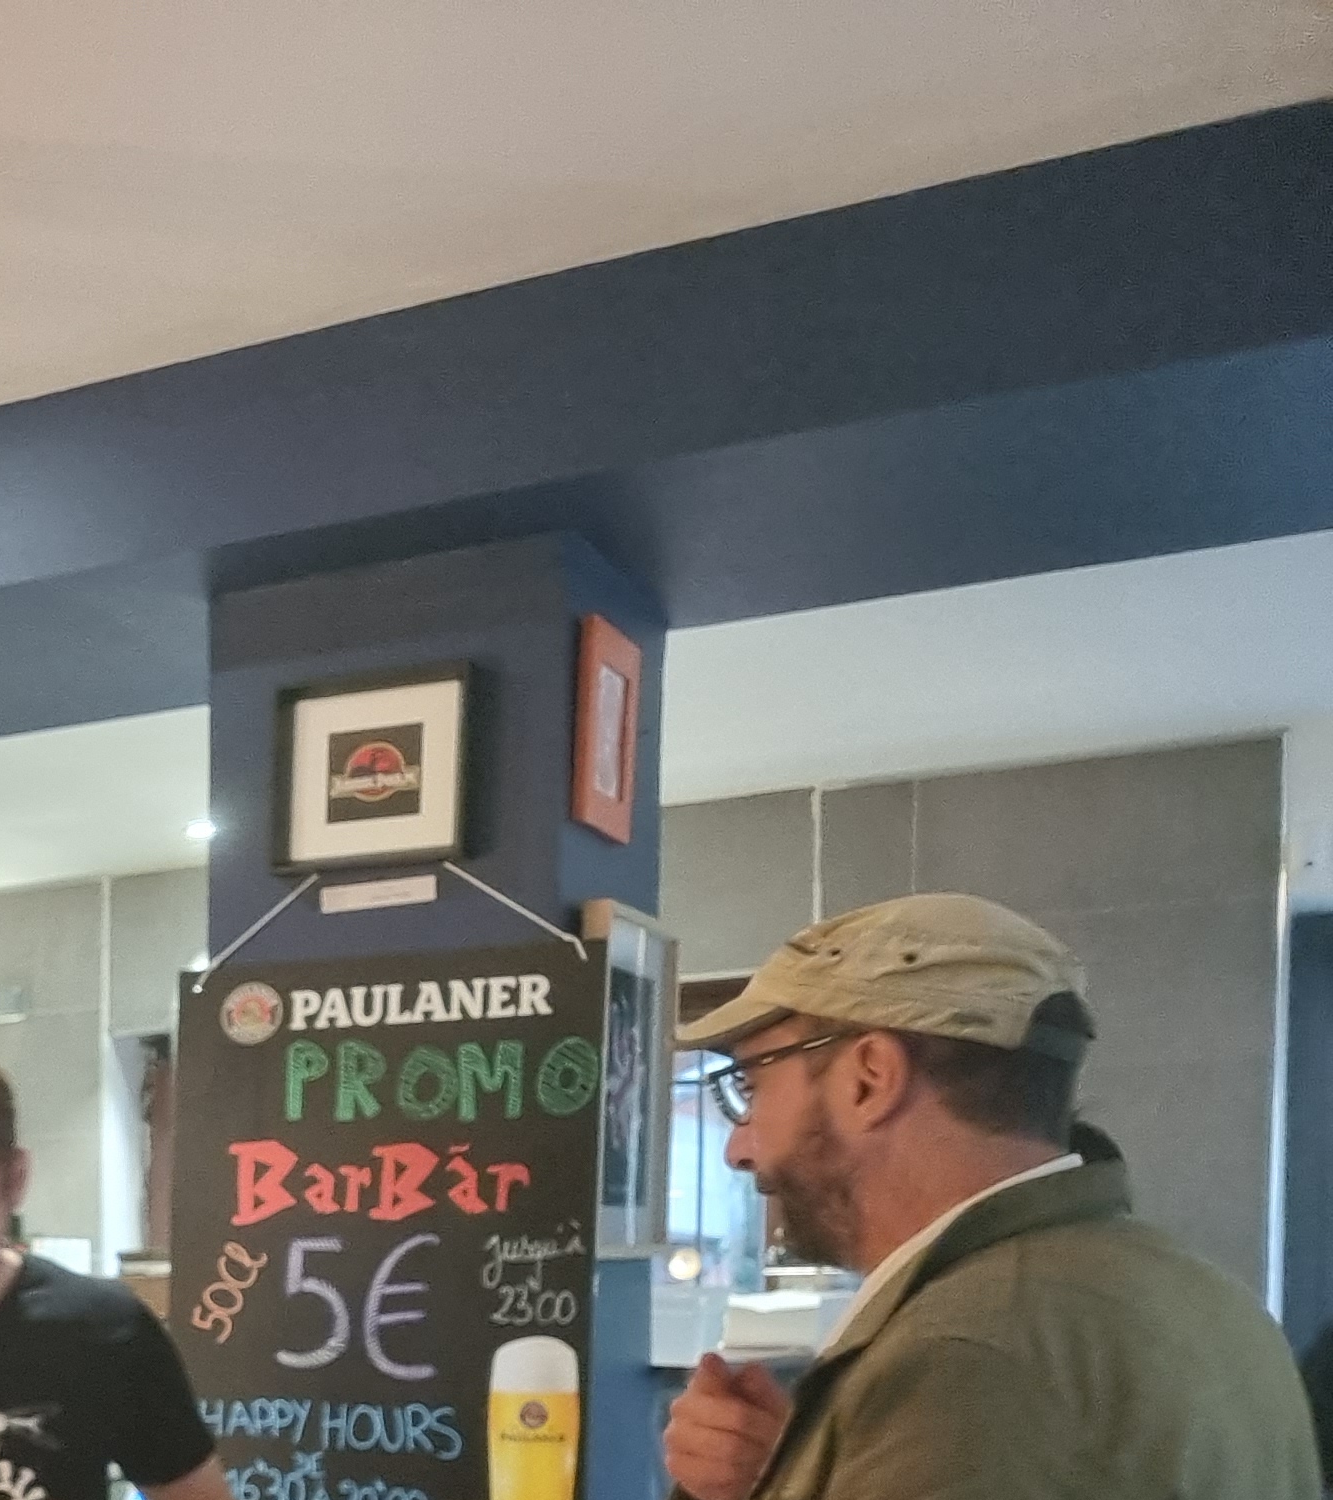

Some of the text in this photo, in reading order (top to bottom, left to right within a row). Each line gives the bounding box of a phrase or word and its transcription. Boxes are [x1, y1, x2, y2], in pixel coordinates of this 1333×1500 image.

[288, 973, 554, 1031] PAULANER
[283, 1036, 601, 1123] PROMO
[275, 1232, 441, 1381] 5€
[197, 1397, 463, 1461] HAPPY HOURS
